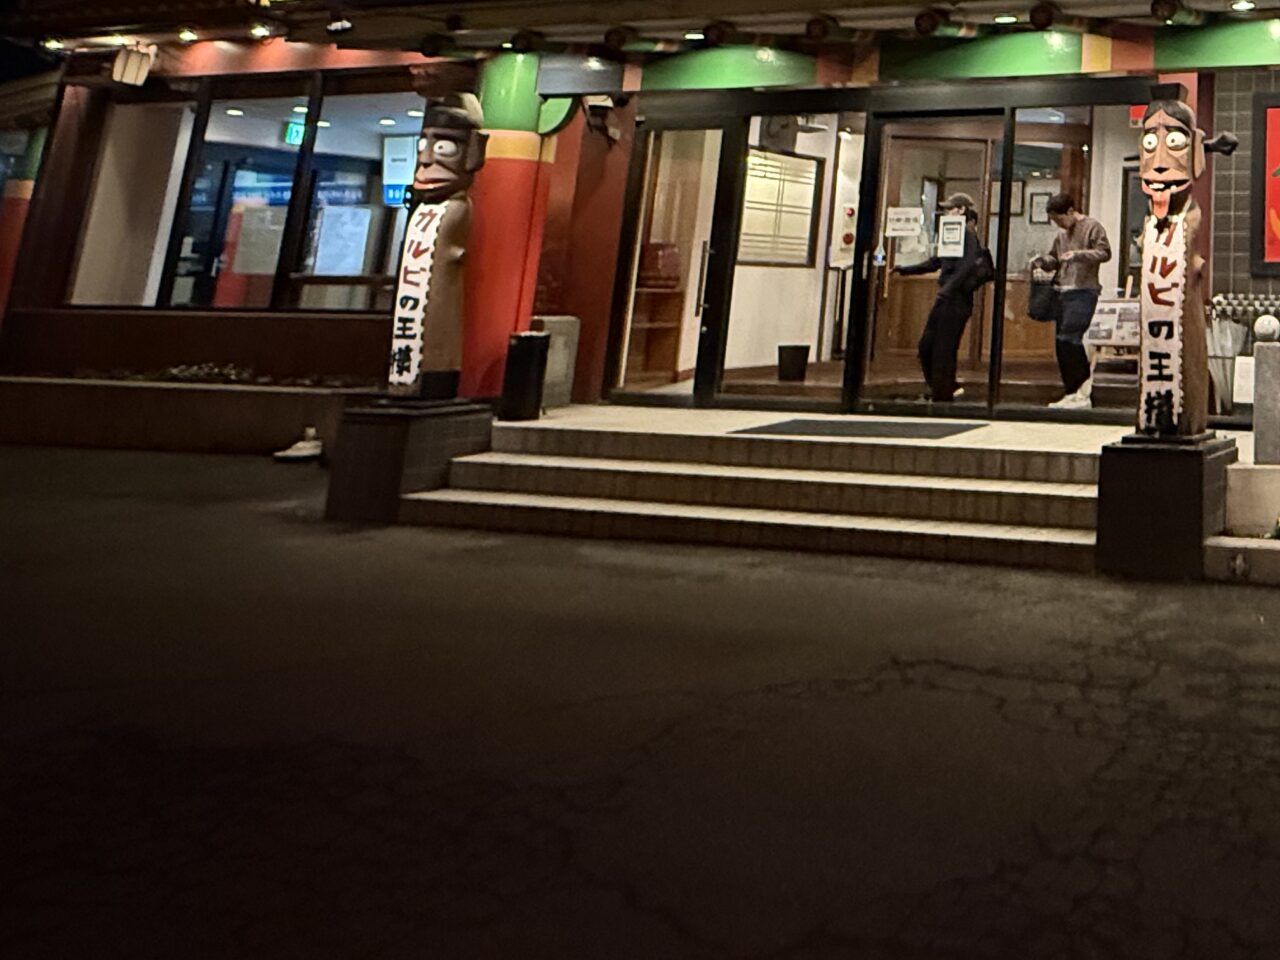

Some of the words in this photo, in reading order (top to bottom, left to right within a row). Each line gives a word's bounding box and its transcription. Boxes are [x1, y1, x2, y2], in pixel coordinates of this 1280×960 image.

[390, 207, 437, 377] カルビの王様
